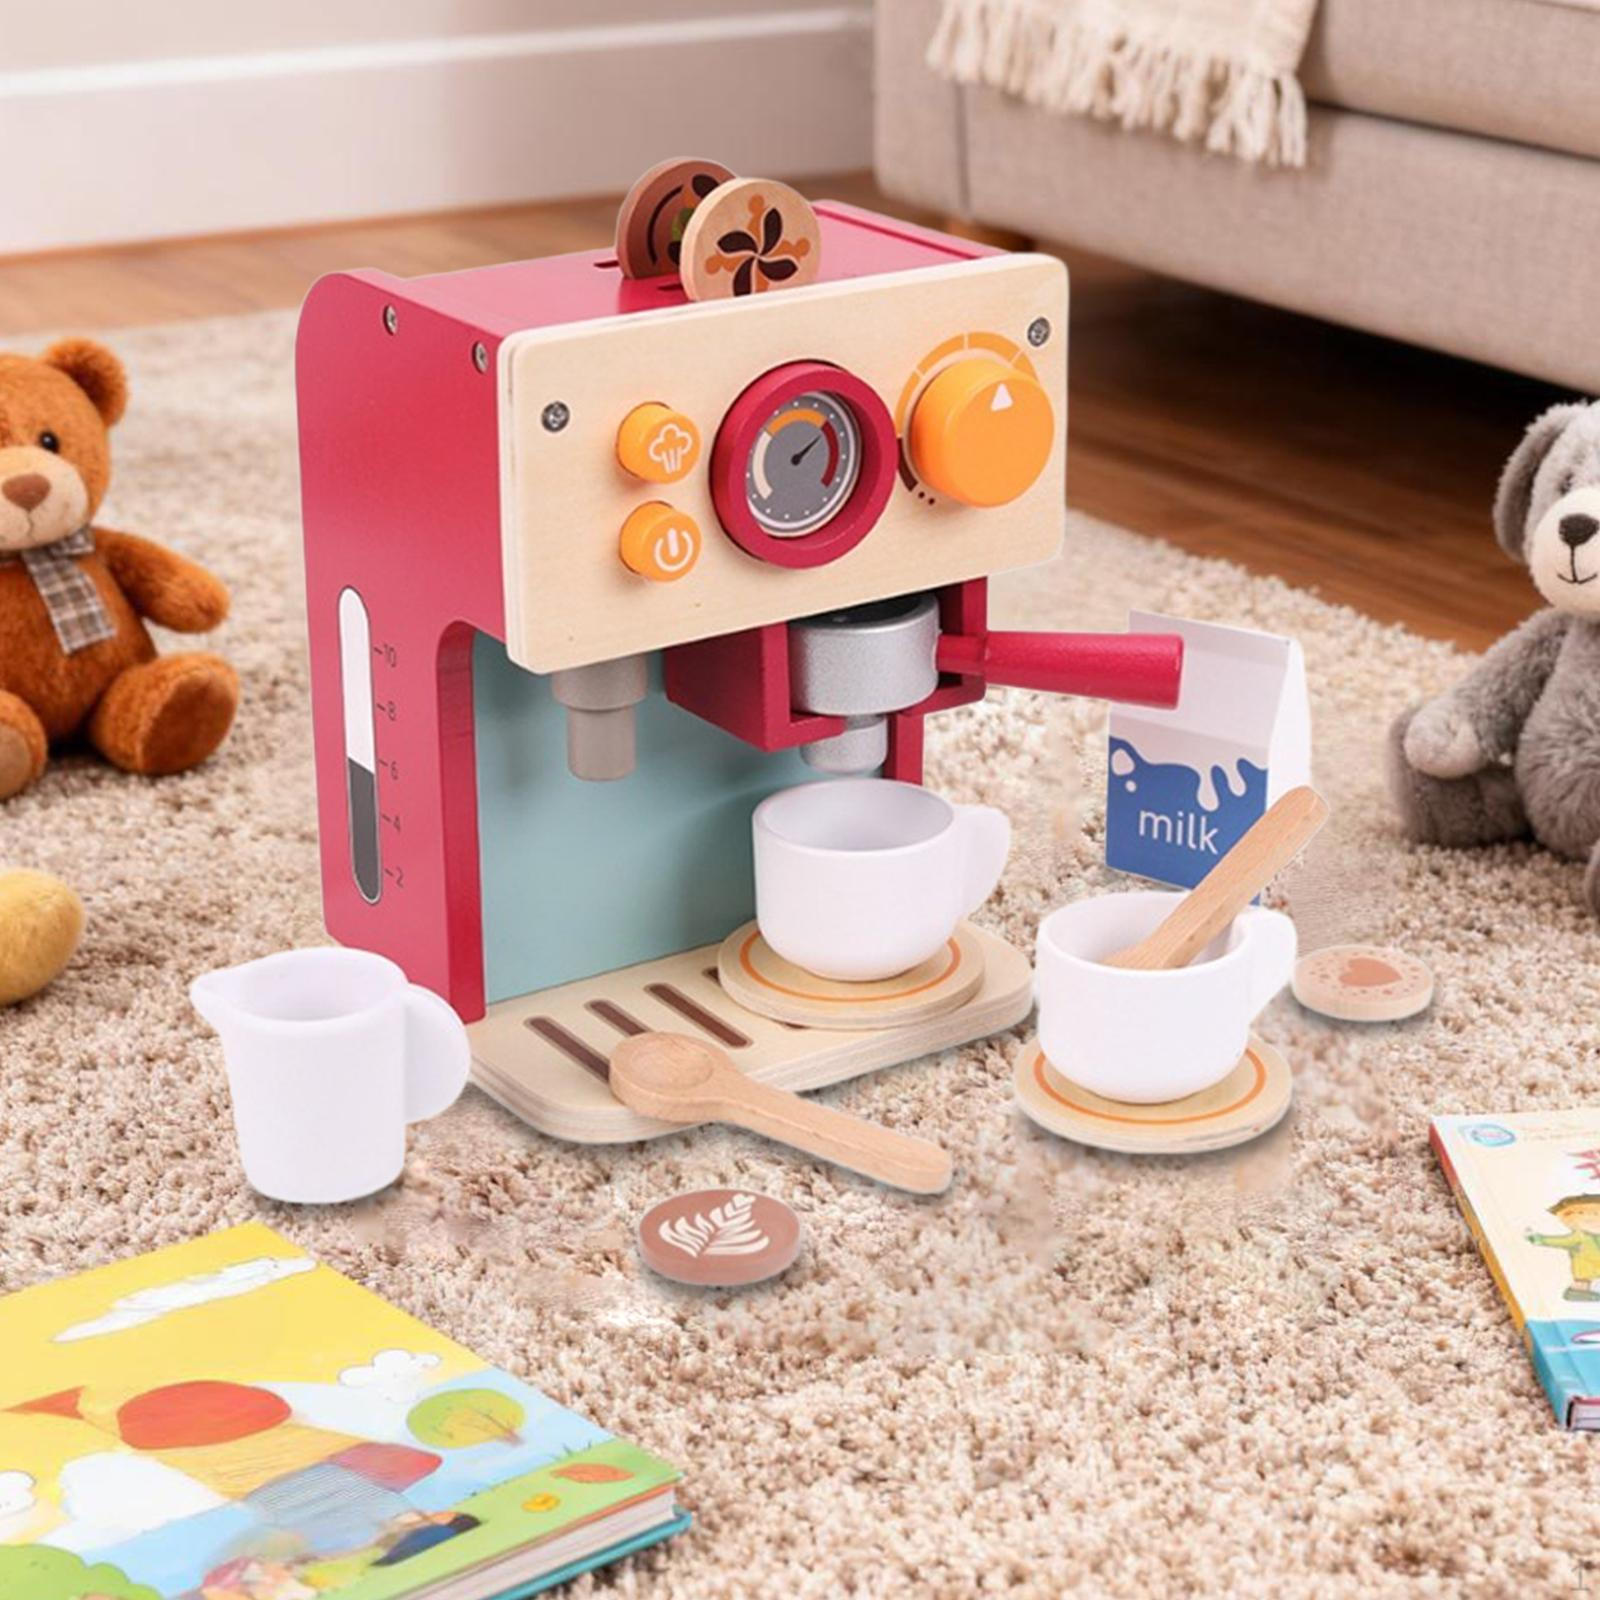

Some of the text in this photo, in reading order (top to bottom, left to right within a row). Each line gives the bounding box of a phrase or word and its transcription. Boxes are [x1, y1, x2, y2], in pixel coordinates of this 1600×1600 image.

[384, 643, 397, 668] 10
[387, 700, 397, 721] 8
[391, 760, 400, 780] 6
[393, 814, 401, 833] 4
[1138, 810, 1219, 855] milk
[396, 866, 404, 888] 2
